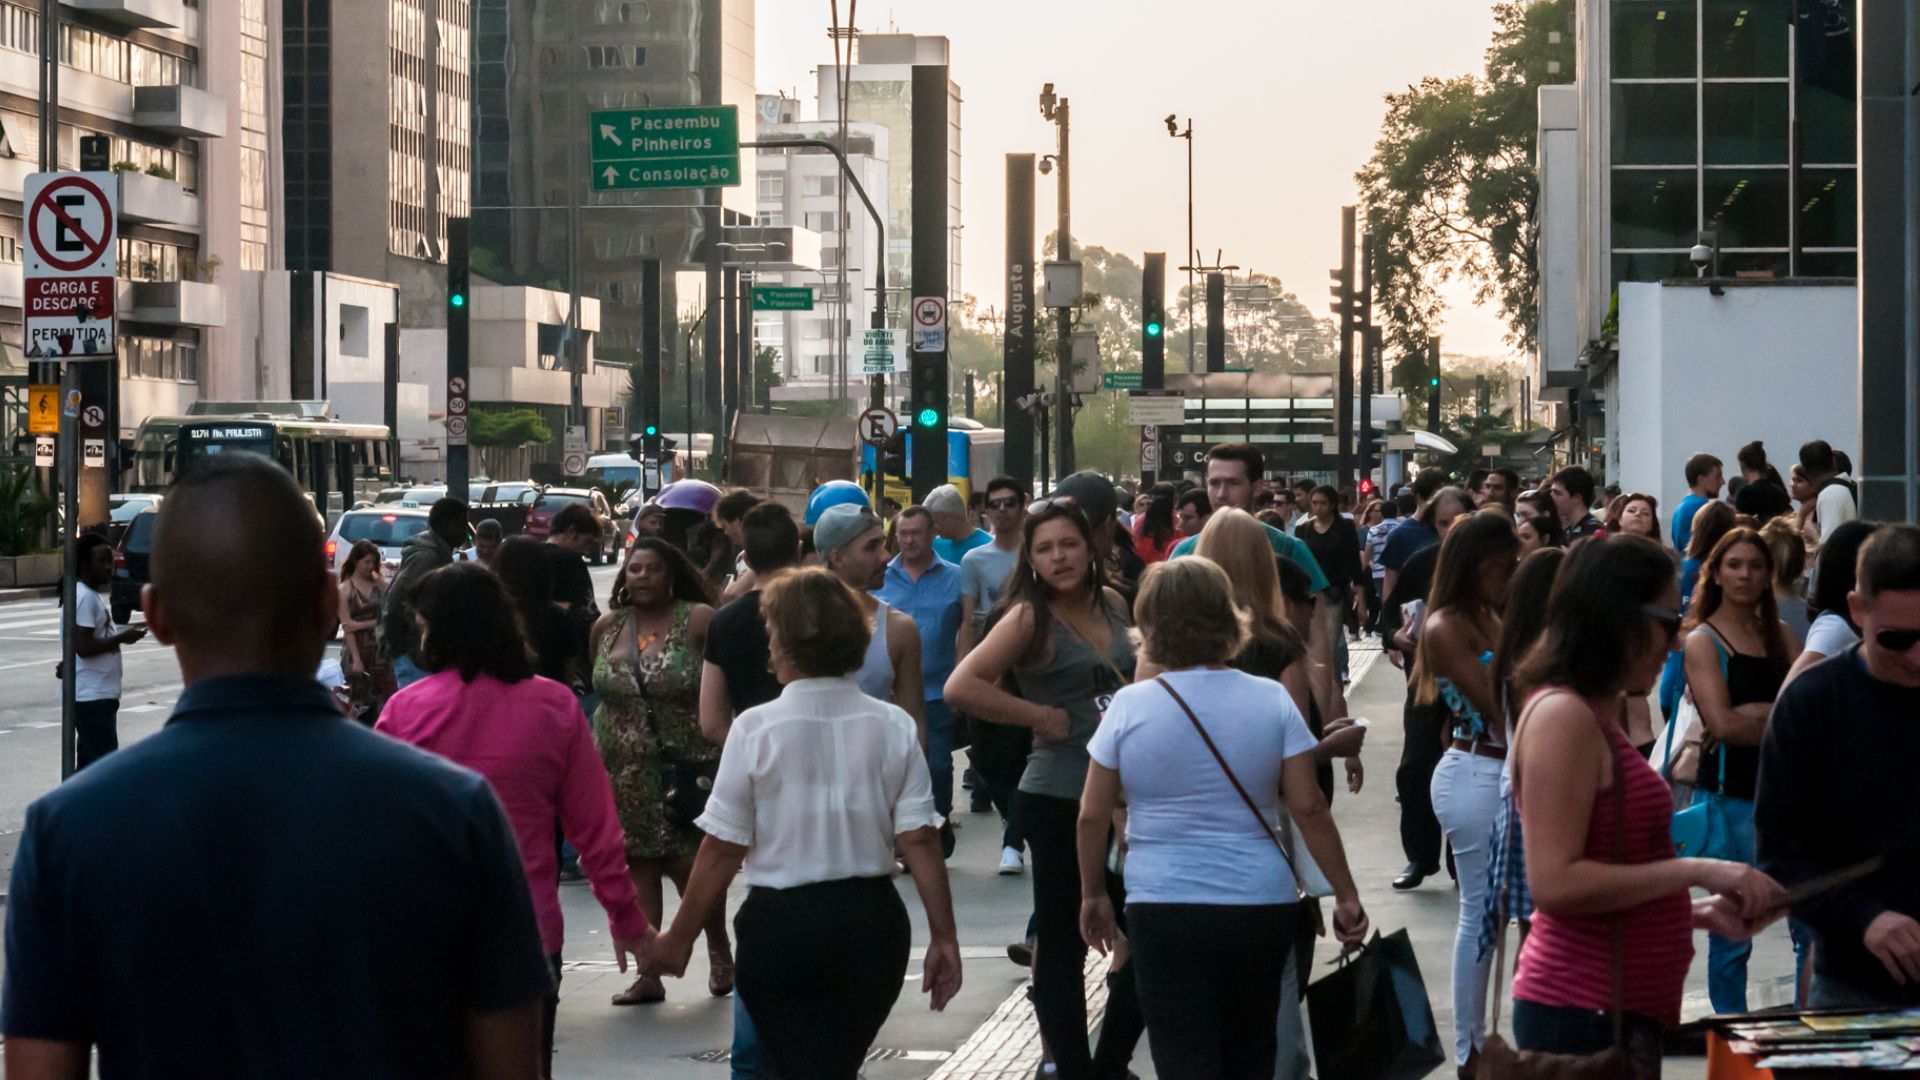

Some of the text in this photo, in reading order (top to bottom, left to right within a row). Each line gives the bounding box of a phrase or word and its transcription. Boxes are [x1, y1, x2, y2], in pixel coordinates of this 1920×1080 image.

[631, 115, 720, 131] Pacaembu
[632, 136, 712, 152] Pinheiros
[629, 165, 729, 182] Consolação
[56, 195, 85, 251] E
[41, 281, 100, 294] CARGA E
[33, 297, 95, 310] DESCARG
[1010, 264, 1027, 338] Augusta
[32, 328, 106, 340] PERMITIDA
[225, 428, 262, 437] PAULISTA
